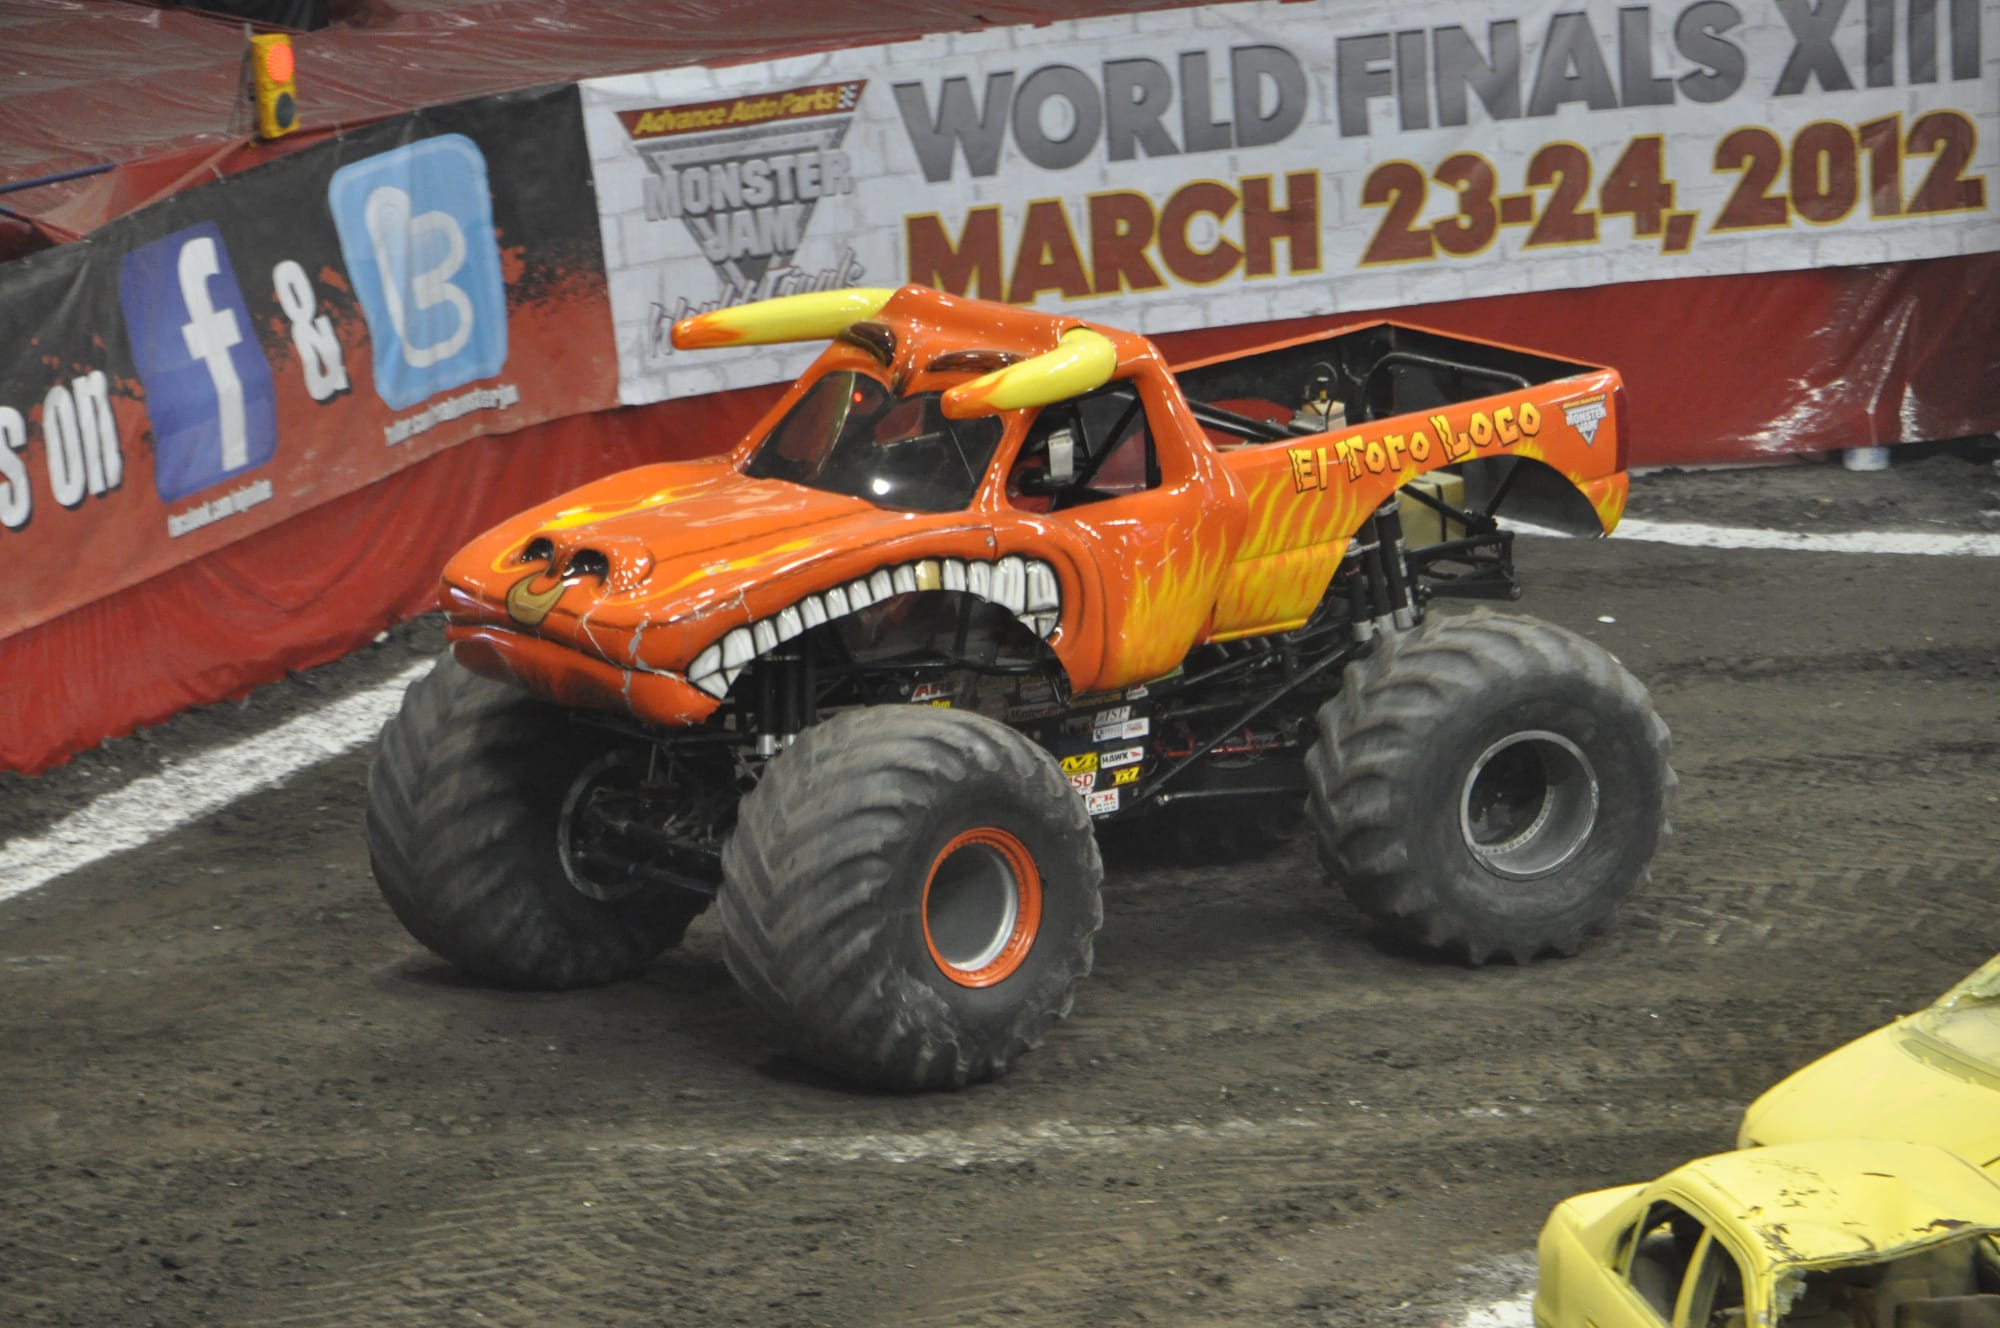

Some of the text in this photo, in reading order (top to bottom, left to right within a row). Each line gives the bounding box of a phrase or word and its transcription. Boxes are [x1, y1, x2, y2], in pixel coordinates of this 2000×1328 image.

[633, 107, 728, 135] Advance
[727, 98, 779, 123] Auto
[891, 0, 1981, 183] WORLD FINALS XIII
[643, 150, 851, 221] MONSTER
[904, 109, 1986, 306] MARCH 23-24, 2012
[699, 203, 798, 265] JAM
[273, 260, 350, 402] &
[1288, 401, 1542, 493] El Toro Loco
[1101, 751, 1129, 764] HAWK
